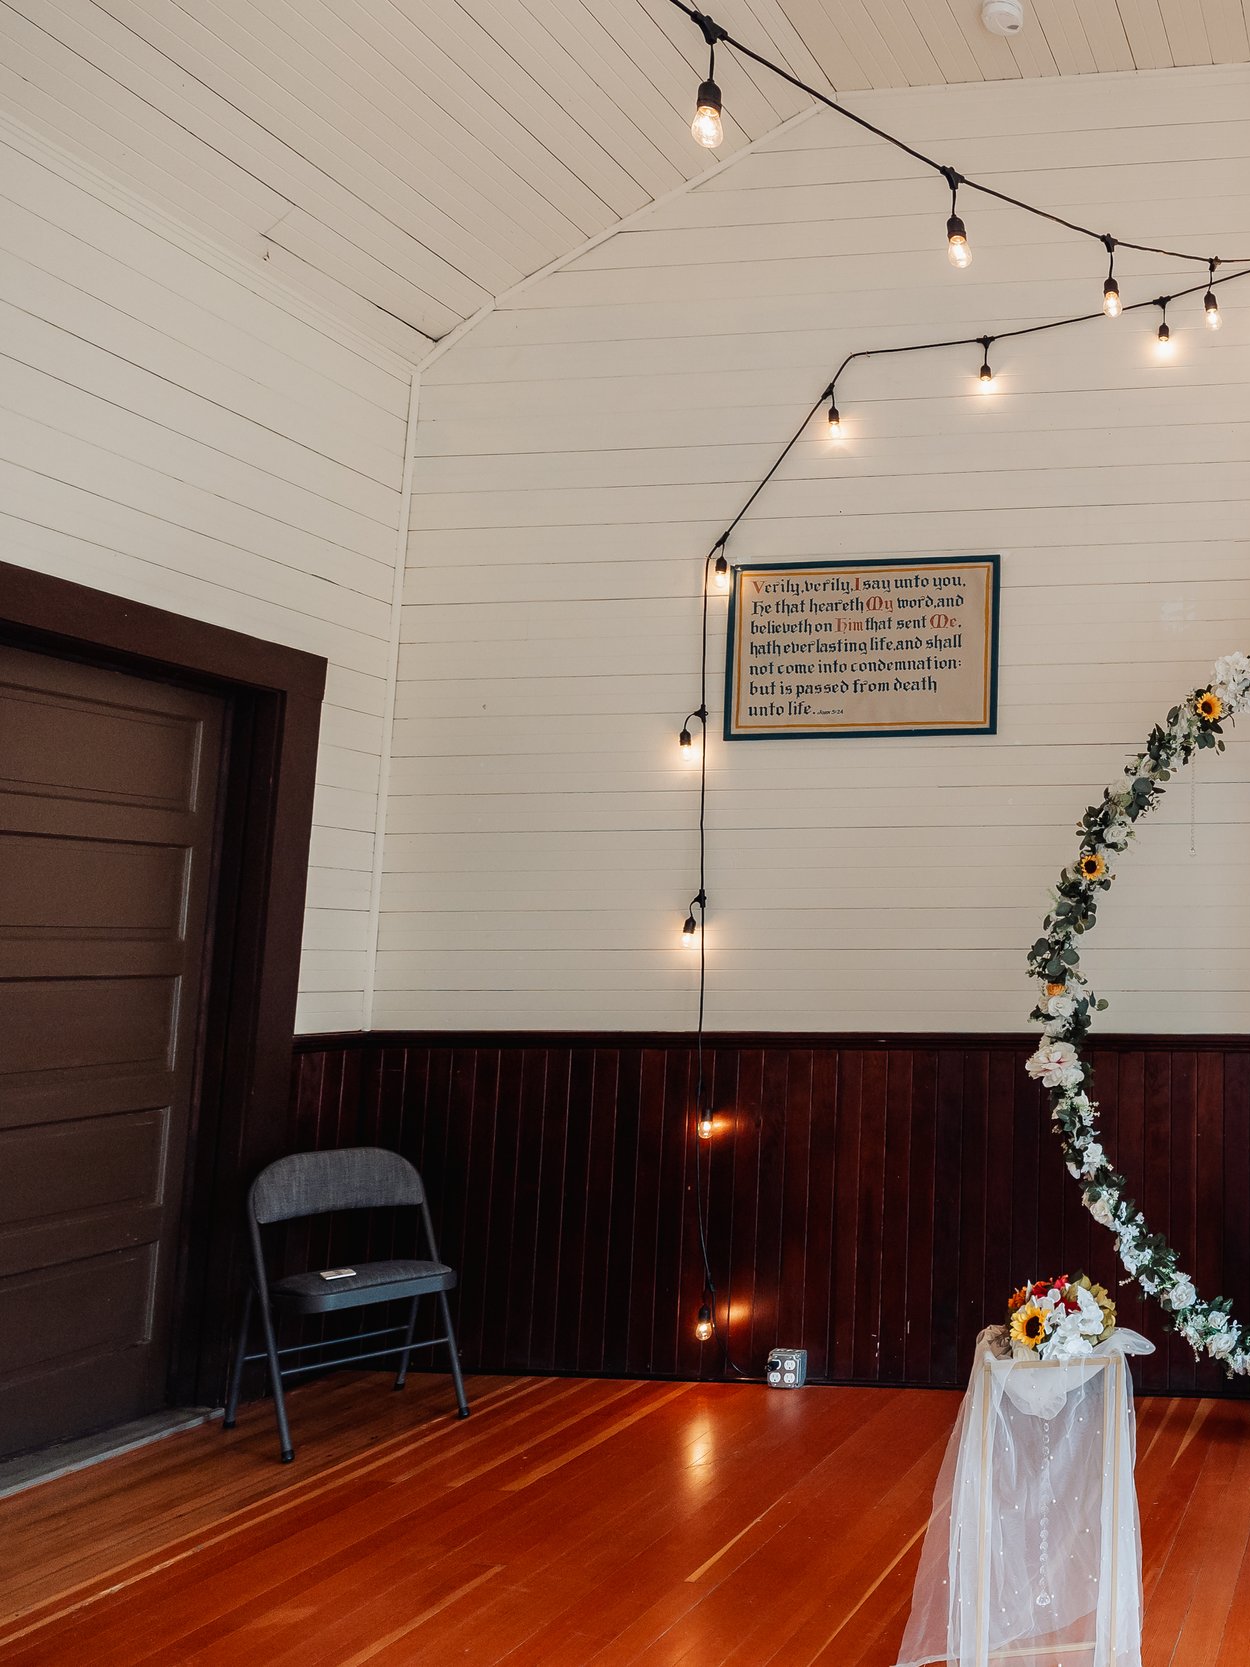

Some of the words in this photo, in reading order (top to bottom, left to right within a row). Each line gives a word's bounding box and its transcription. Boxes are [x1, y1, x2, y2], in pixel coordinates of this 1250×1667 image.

[854, 577, 861, 591] I
[863, 579, 891, 593] say
[894, 575, 929, 588] unto
[751, 601, 772, 616] He
[775, 599, 805, 616] that
[810, 597, 864, 615] heareth
[866, 595, 893, 613] My
[937, 594, 964, 607] and
[751, 619, 812, 635] believeth
[815, 622, 832, 632] on
[834, 618, 863, 634] Him
[865, 617, 892, 632] that
[897, 615, 927, 630] sent
[750, 640, 781, 658] hath
[783, 639, 867, 655] everlasting
[896, 637, 923, 650] and
[926, 633, 962, 651] shall
[750, 662, 774, 675] not
[777, 664, 815, 674] come
[818, 660, 847, 673] into
[851, 656, 961, 672] condemnation:
[749, 681, 776, 696] but
[780, 681, 792, 695] is
[796, 680, 849, 698] passed
[853, 679, 889, 693] from
[894, 676, 937, 693] death
[748, 702, 784, 716] unto
[788, 701, 815, 716] life.
